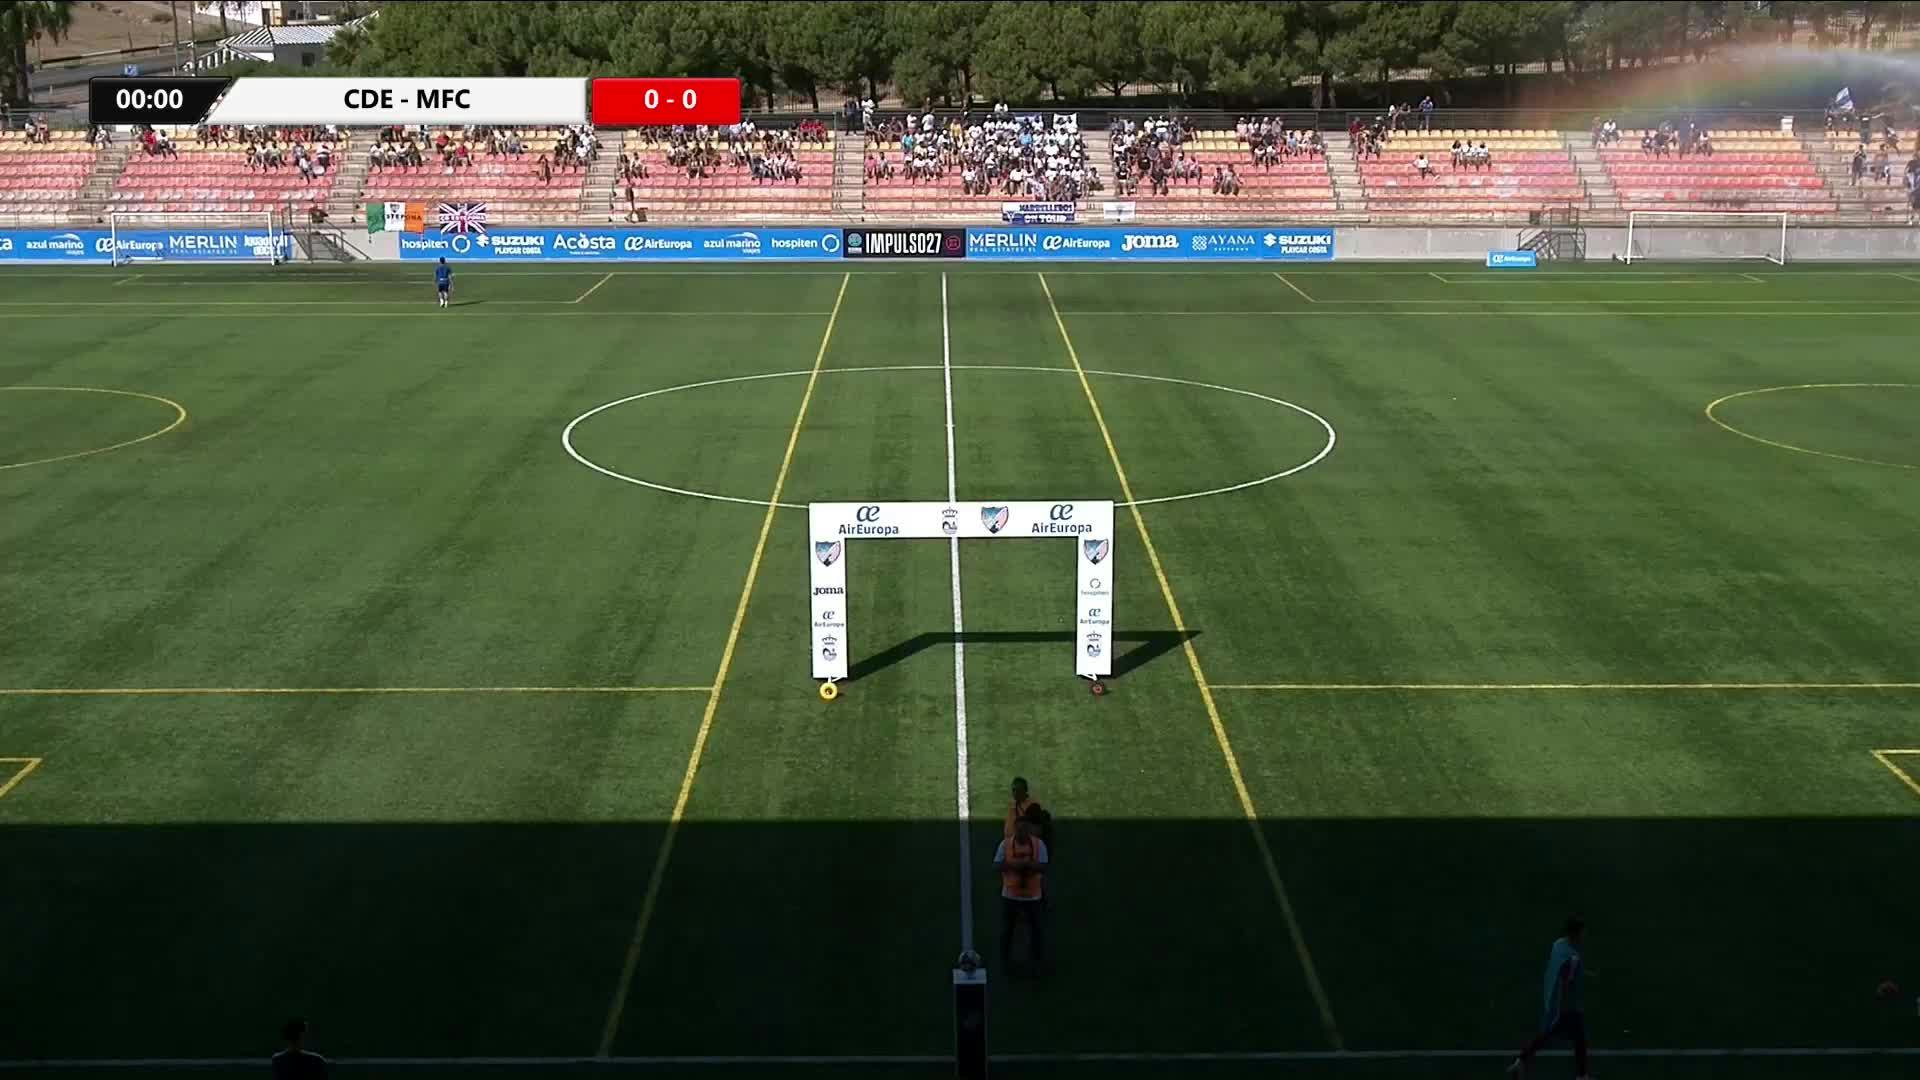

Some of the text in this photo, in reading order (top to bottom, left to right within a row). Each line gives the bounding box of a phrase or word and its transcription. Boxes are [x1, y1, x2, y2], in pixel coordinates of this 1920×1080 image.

[26, 240, 84, 249] azul marino
[169, 235, 237, 248] MERLIN
[401, 239, 449, 250] hospiten
[491, 235, 545, 246] SUZUKI
[644, 239, 692, 250] AirEuropa
[703, 239, 761, 248] azul marino
[771, 238, 818, 249] hospiten
[865, 233, 942, 254] IMPULSO27
[969, 233, 1037, 247] MERLIN
[1062, 238, 1111, 249] AirEuropa
[1208, 235, 1256, 245] AYANA
[1278, 235, 1332, 245] SUZUKI
[838, 524, 899, 536] AirEuropa
[1031, 522, 1092, 534] AirEuropa
